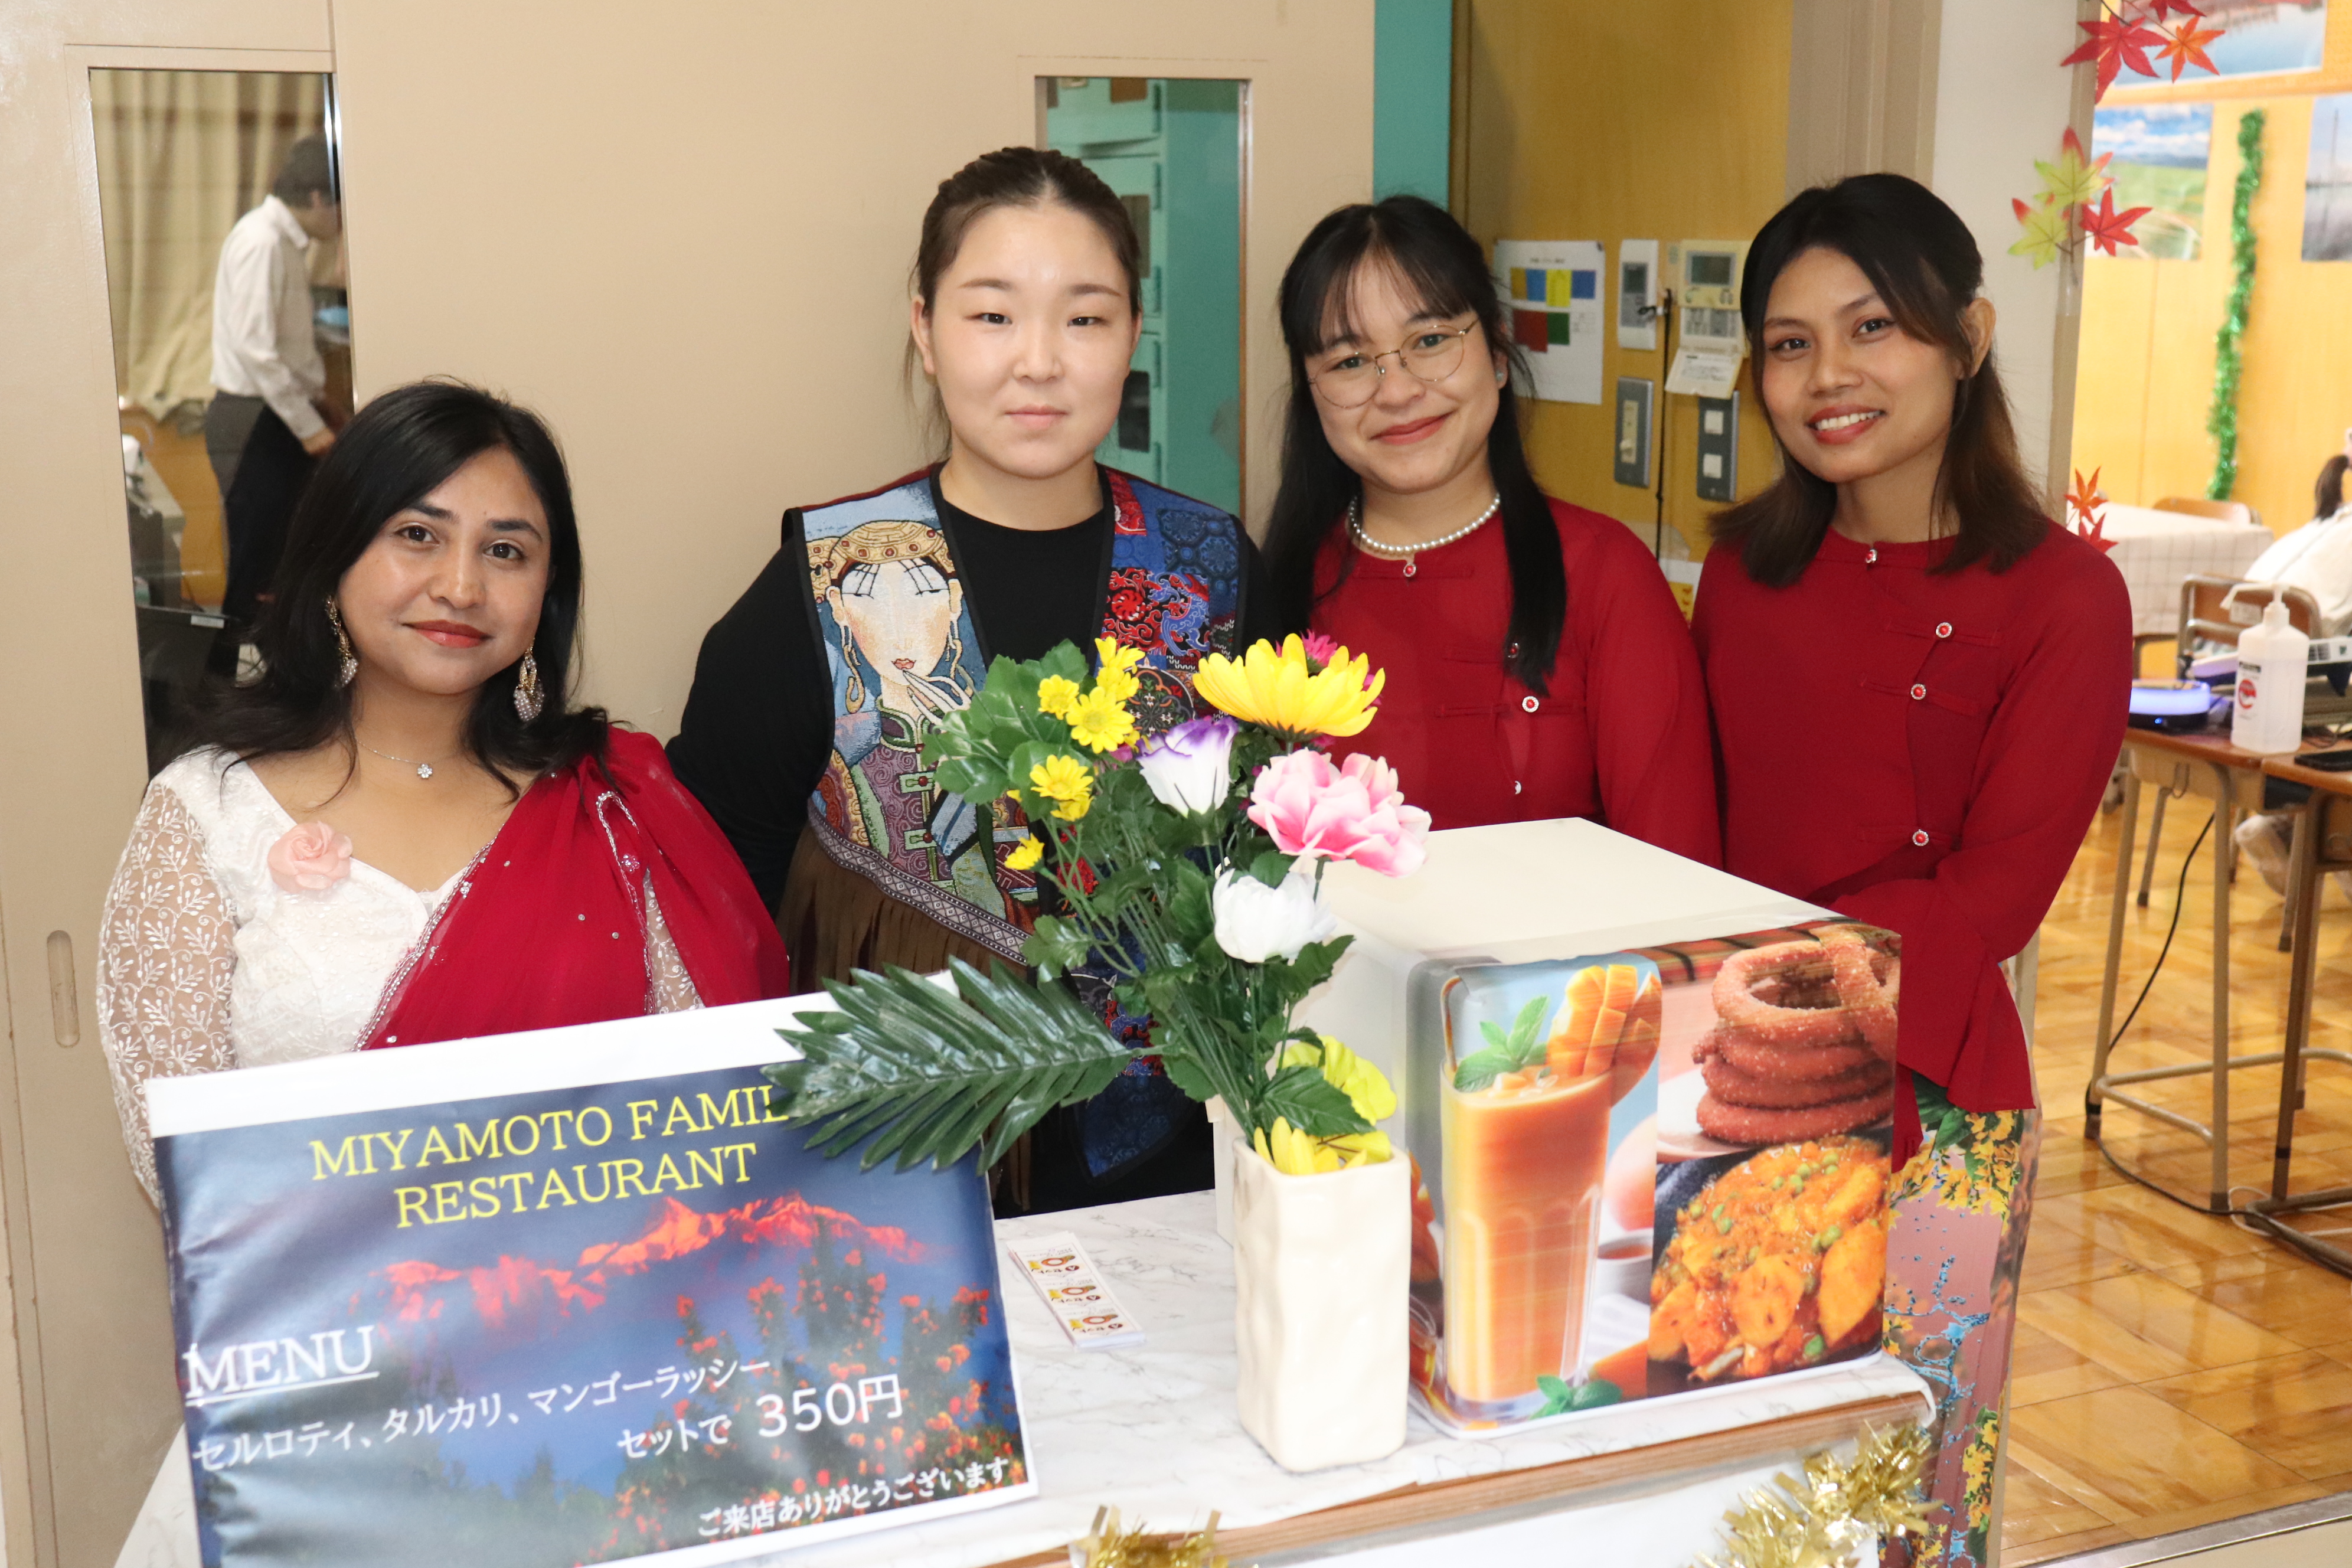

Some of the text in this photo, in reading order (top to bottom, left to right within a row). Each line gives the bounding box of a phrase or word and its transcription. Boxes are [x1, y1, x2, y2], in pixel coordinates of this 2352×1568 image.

[309, 1084, 790, 1181] MIYAMOTO FAMIL
[394, 1142, 757, 1229] RESTAURANT
[182, 1325, 377, 1402] MENU
[616, 1373, 903, 1460] セットで 350円
[697, 1455, 1009, 1537] ご来店ありがとうございます
